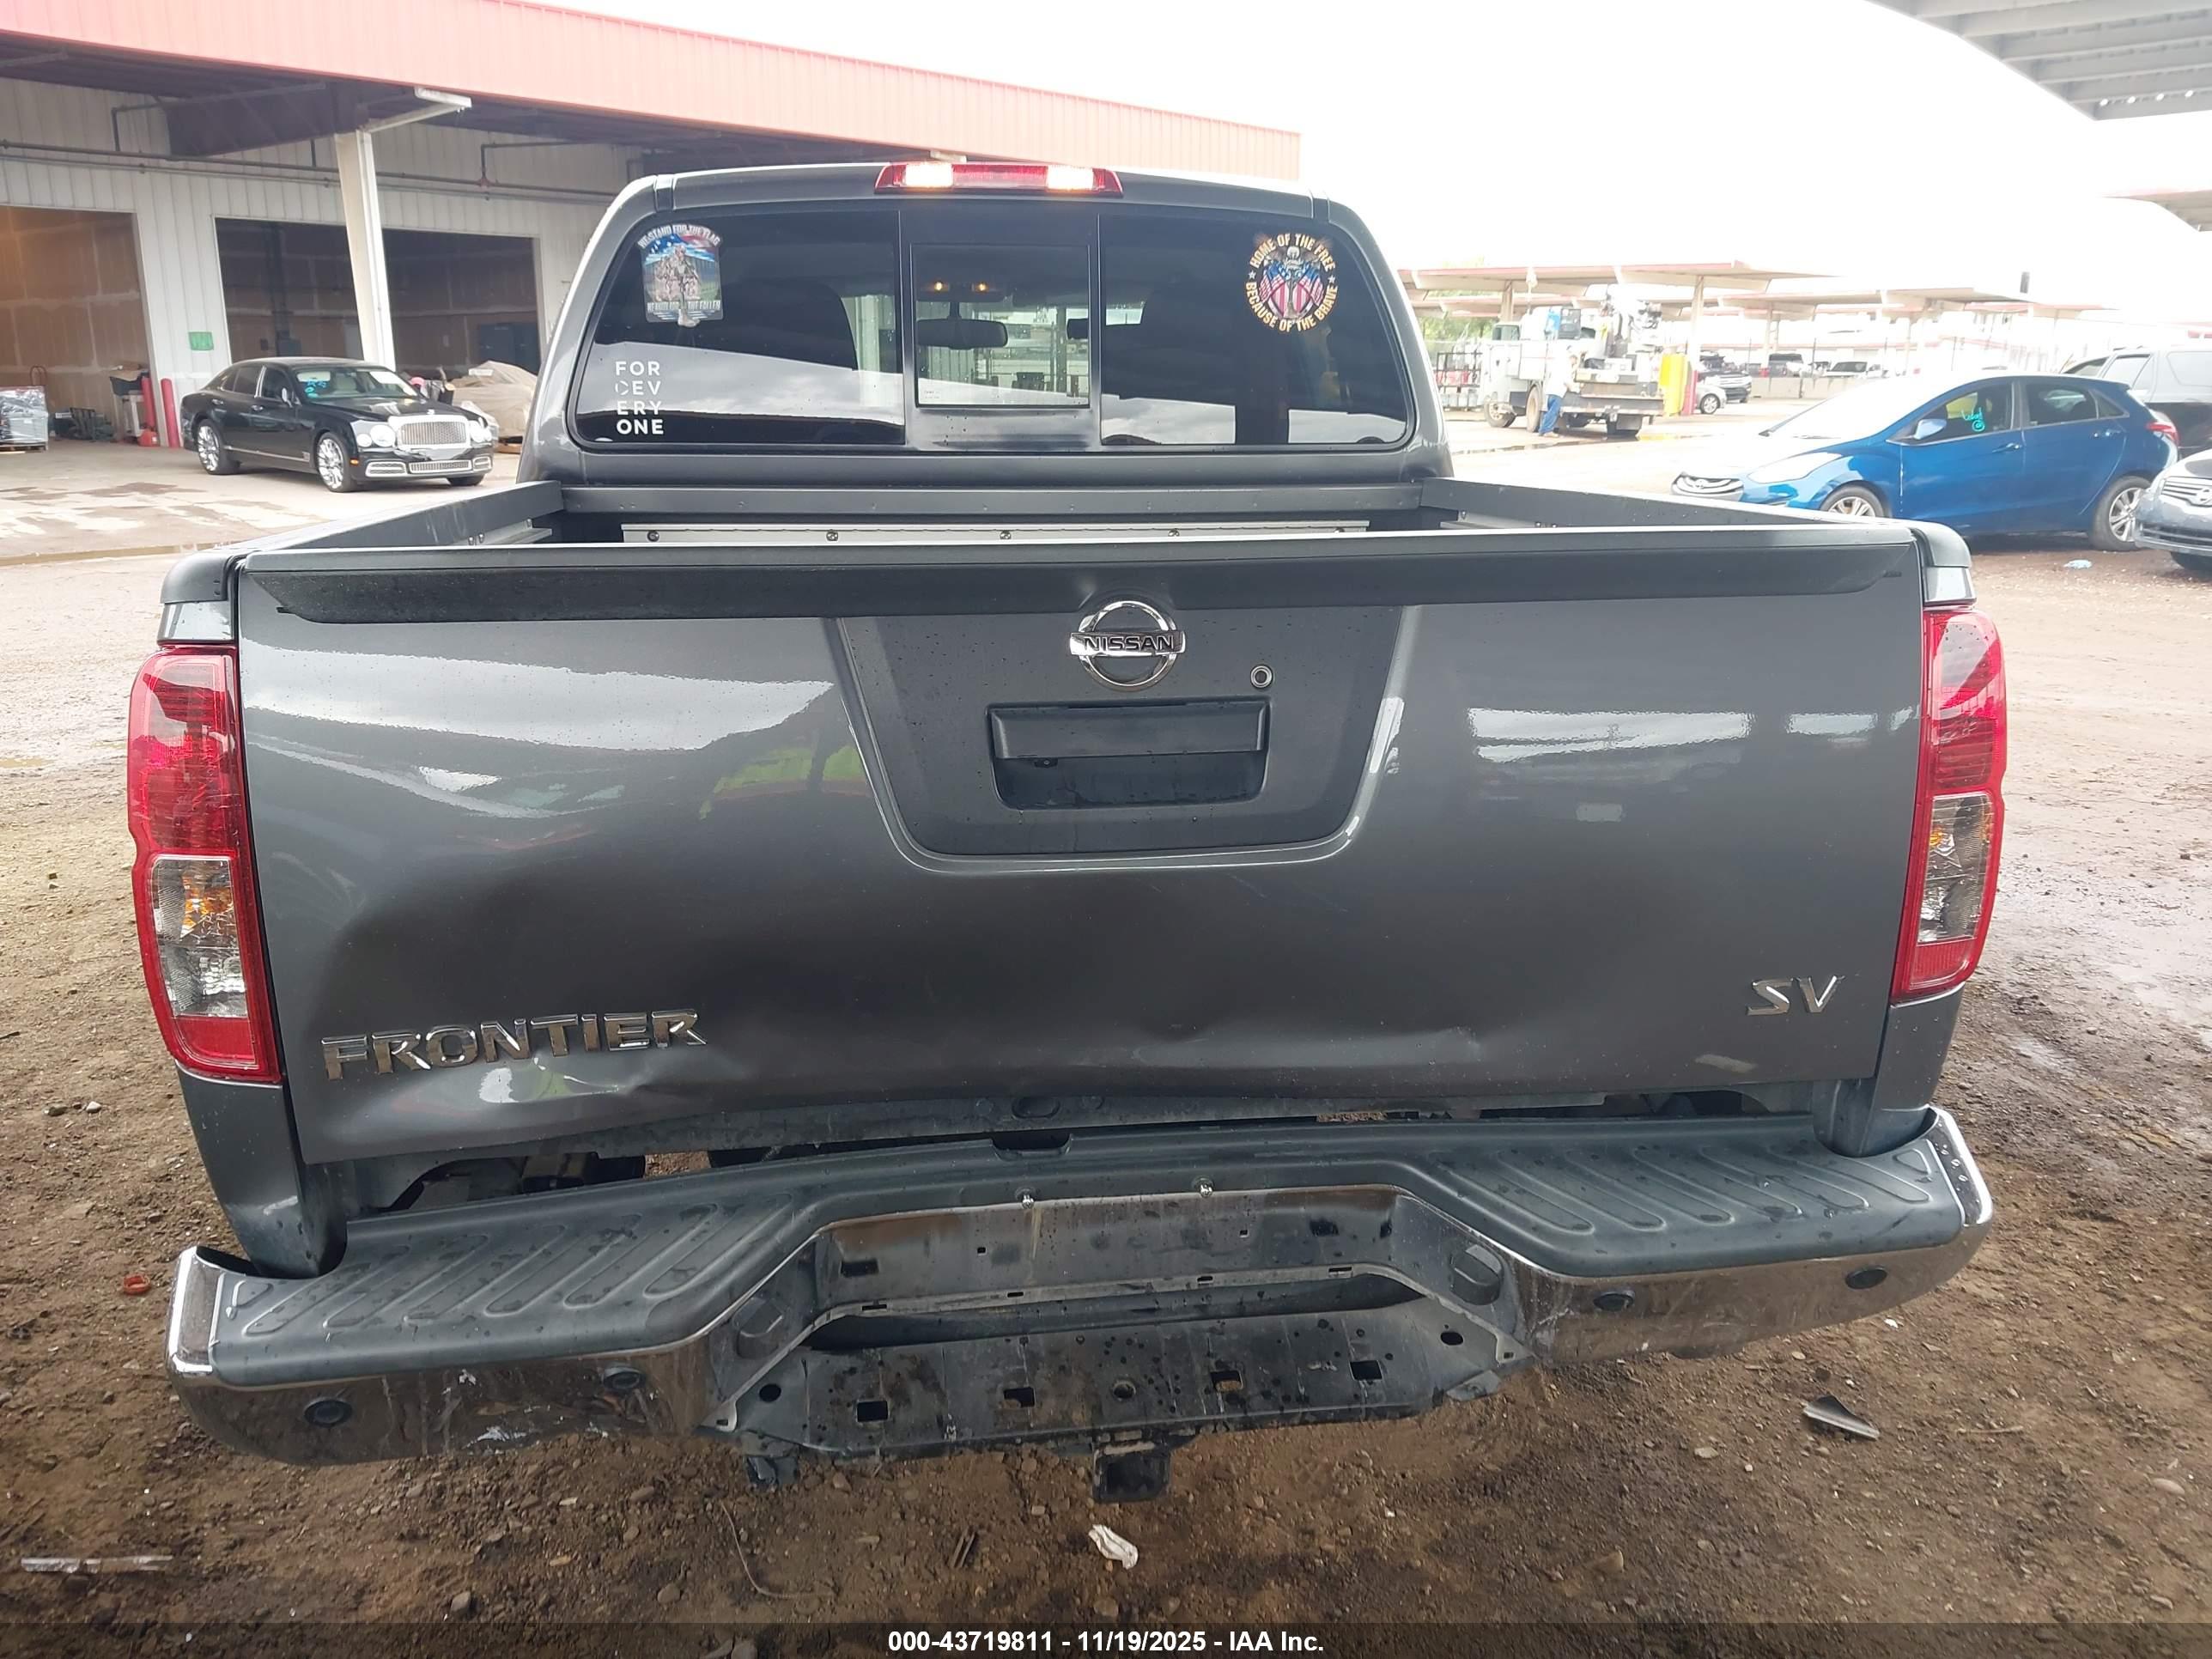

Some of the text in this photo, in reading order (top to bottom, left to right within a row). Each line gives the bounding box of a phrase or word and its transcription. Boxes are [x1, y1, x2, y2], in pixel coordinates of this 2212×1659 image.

[647, 225, 672, 241] STAND
[672, 224, 687, 234] FOR
[688, 224, 702, 237] THE
[702, 227, 721, 246] FLAG
[1249, 233, 1336, 272] HOME OF THE FREE
[1245, 282, 1339, 332] BECAUSE OF THE BRAVE
[616, 361, 660, 376] FOR
[617, 400, 661, 416] ERY
[617, 419, 664, 435] ONE
[1084, 635, 1175, 652] NISSAN
[1747, 975, 1845, 1017] SV
[321, 1008, 708, 1080] FRONTIER
